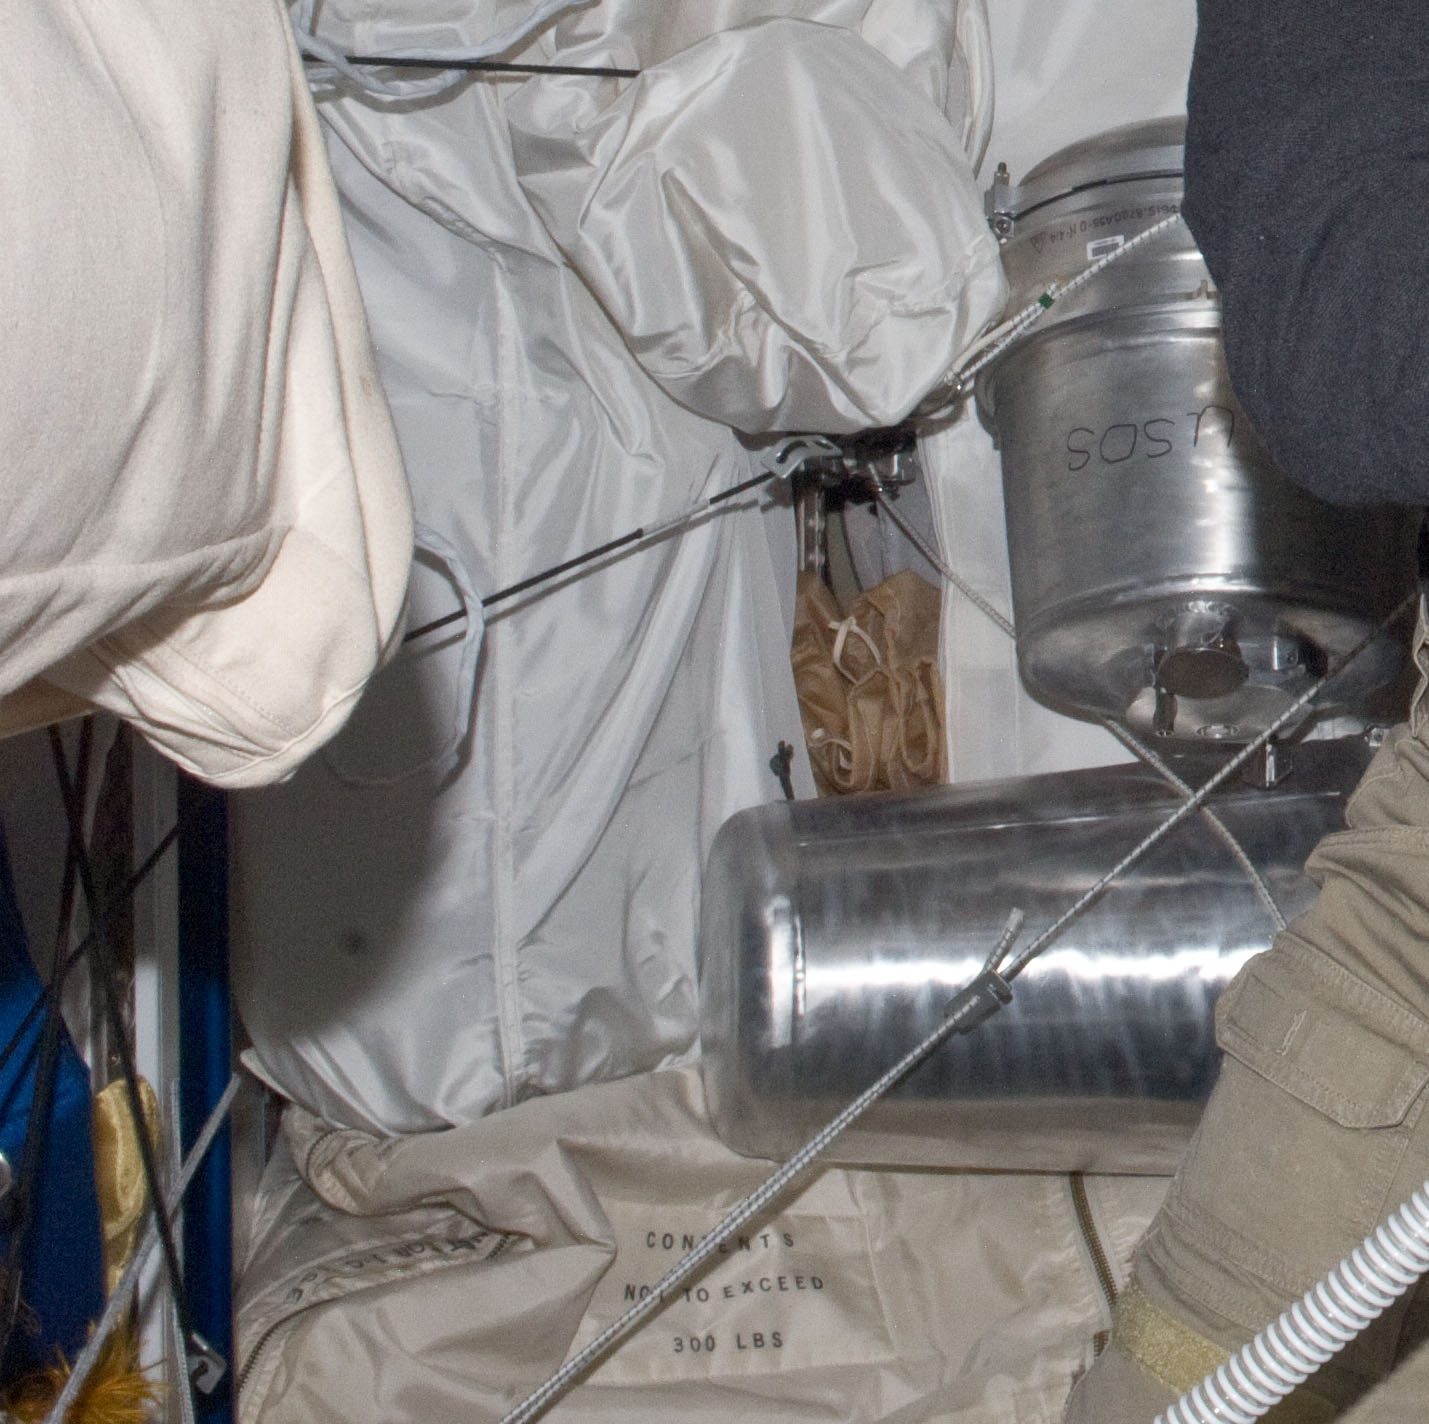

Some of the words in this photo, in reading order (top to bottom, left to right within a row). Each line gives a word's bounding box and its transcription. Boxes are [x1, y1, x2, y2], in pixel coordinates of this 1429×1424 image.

[647, 1231, 793, 1255] CONENTS
[723, 1276, 824, 1299] EXCEED
[673, 1335, 715, 1353] 300
[736, 1331, 783, 1350] LBS
